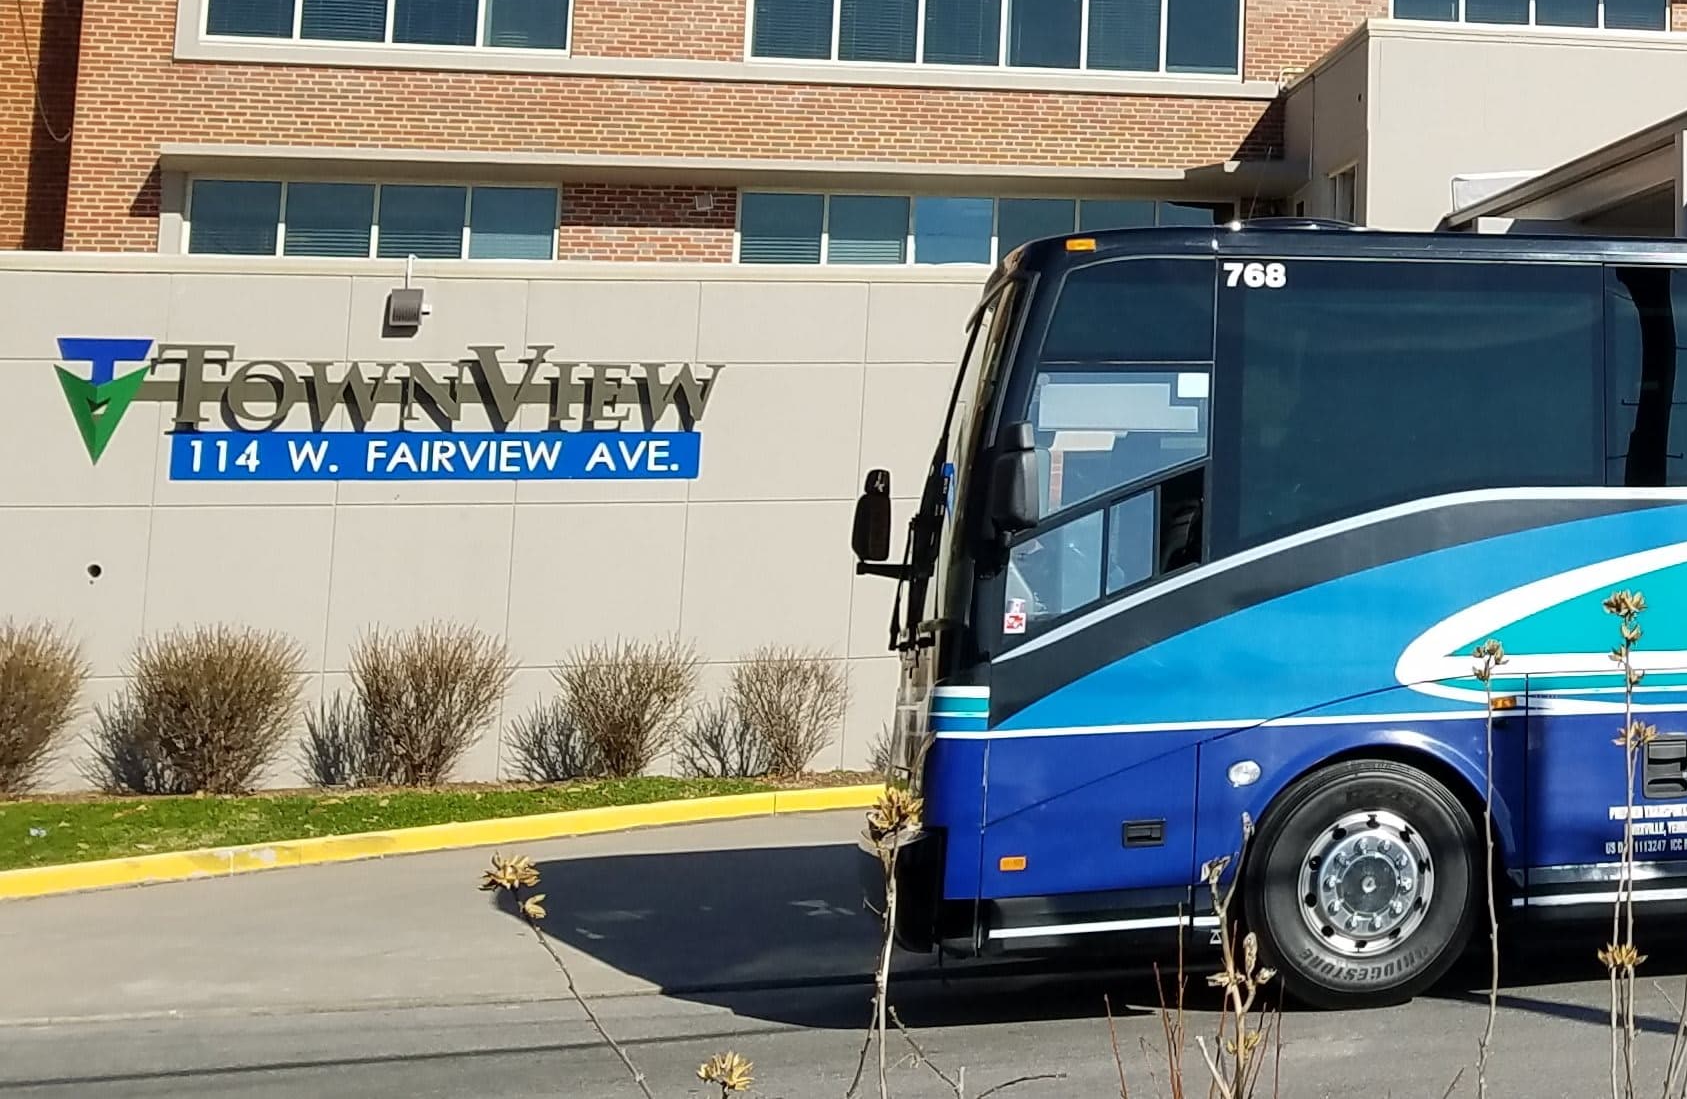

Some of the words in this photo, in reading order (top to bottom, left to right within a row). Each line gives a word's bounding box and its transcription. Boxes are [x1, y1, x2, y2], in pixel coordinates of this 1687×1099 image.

[1222, 262, 1287, 288] 768
[151, 343, 727, 424] TOWNVIEW
[189, 439, 260, 474] 114
[287, 439, 339, 474] W.
[365, 439, 571, 474] FAIRVIEW
[584, 439, 680, 474] AVE.
